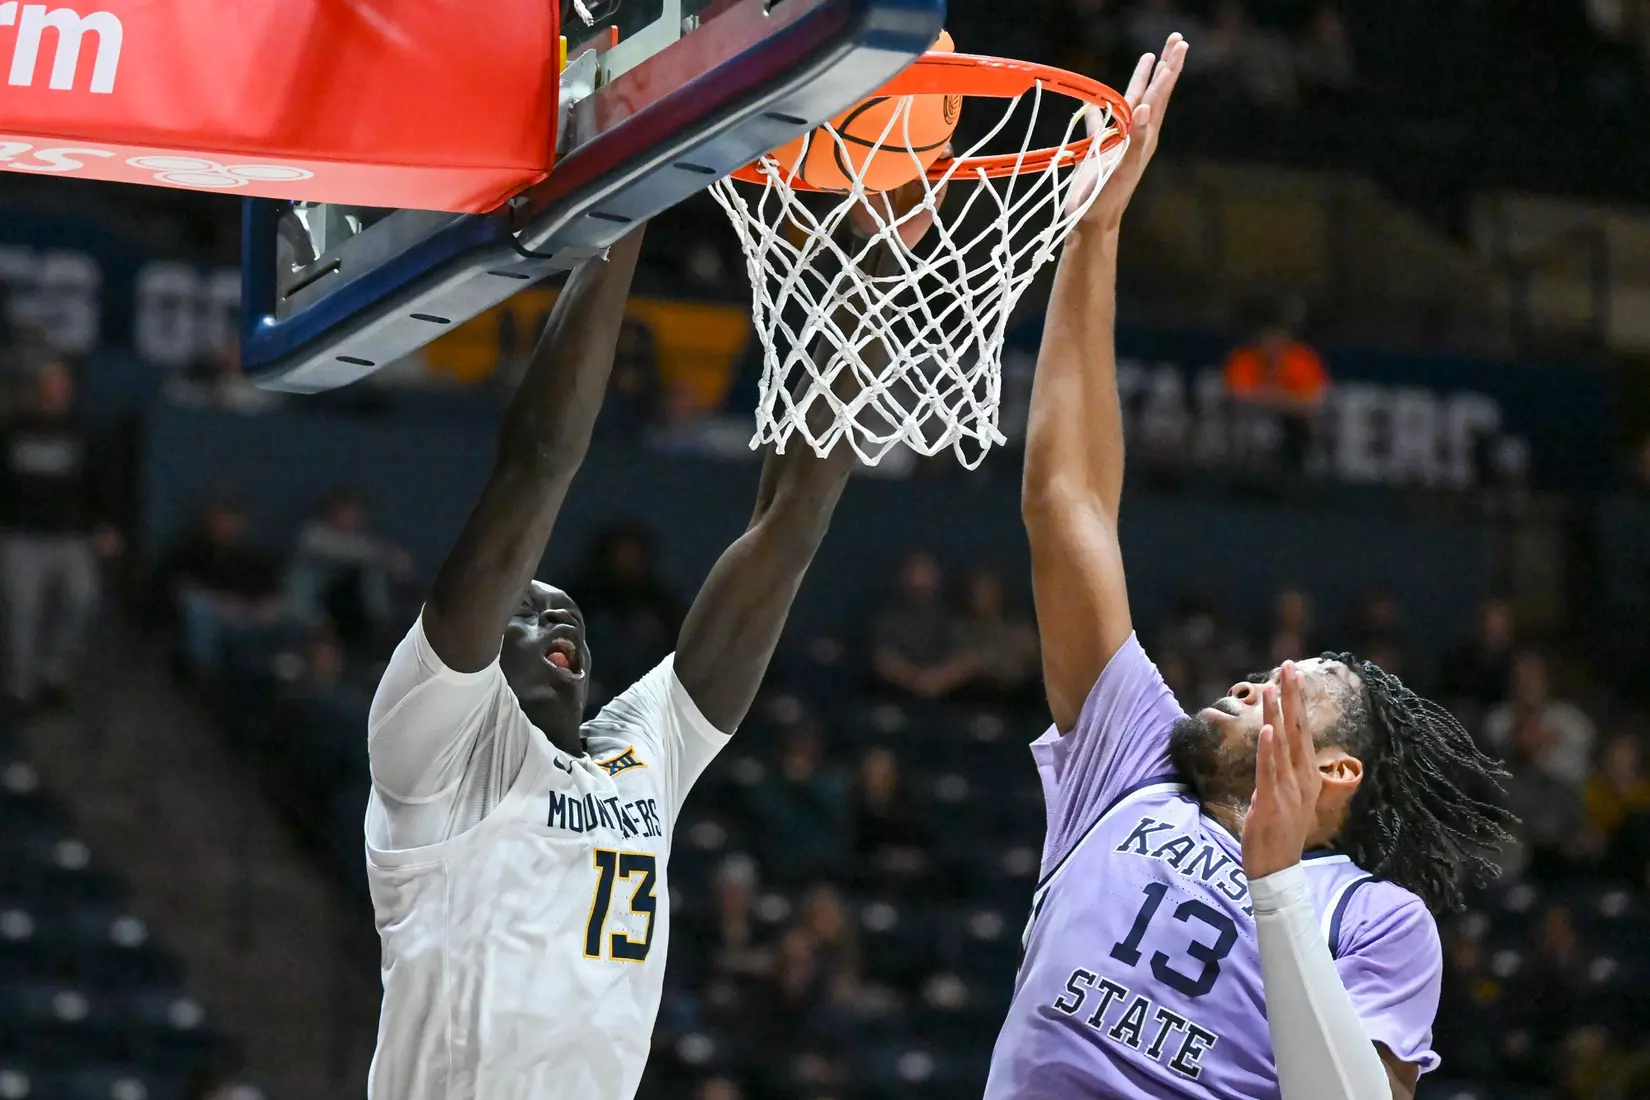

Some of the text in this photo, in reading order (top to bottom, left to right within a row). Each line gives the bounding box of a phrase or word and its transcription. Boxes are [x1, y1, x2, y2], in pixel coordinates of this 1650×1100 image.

[583, 847, 657, 963] 13
[1113, 815, 1254, 918] KANS
[1109, 882, 1238, 998] 13
[1052, 967, 1219, 1080] STATE
